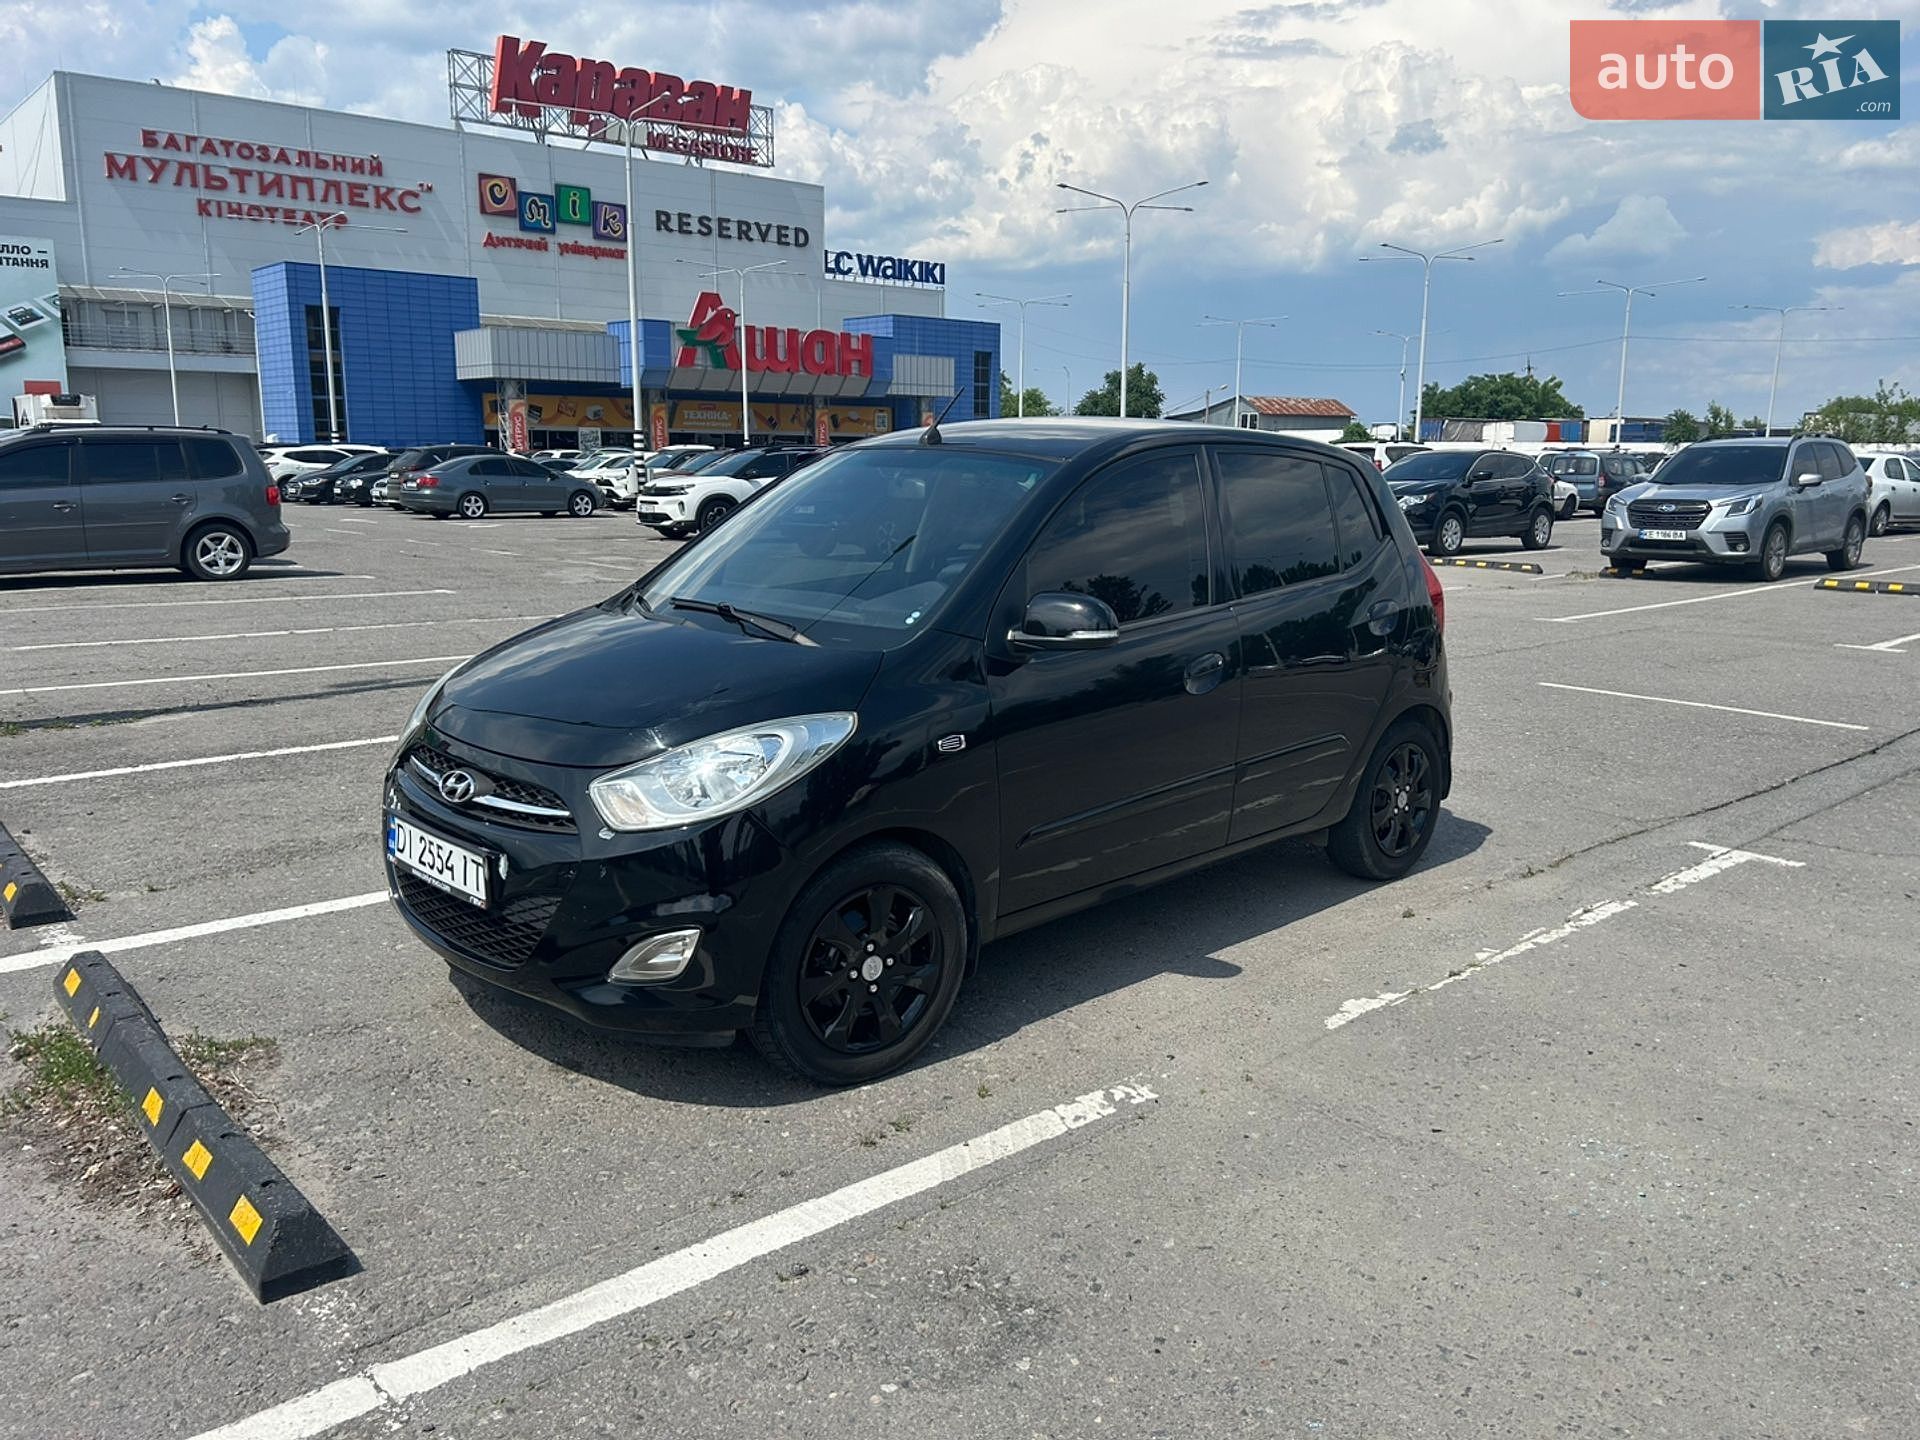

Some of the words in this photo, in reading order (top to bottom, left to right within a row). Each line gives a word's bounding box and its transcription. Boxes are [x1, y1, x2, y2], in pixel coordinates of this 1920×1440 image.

[491, 35, 752, 137] Караван
[140, 128, 383, 177] БАГАТОЗАЛЬНИЙ
[647, 131, 758, 164] MEGASTORE
[104, 152, 423, 213] МУЛЬТИПЛЕКС
[196, 198, 349, 229] КІНОТЕАТР
[655, 209, 810, 248] RESERVED
[824, 249, 853, 276] LC
[676, 291, 873, 377] Ашан
[418, 836, 455, 881] 2554
